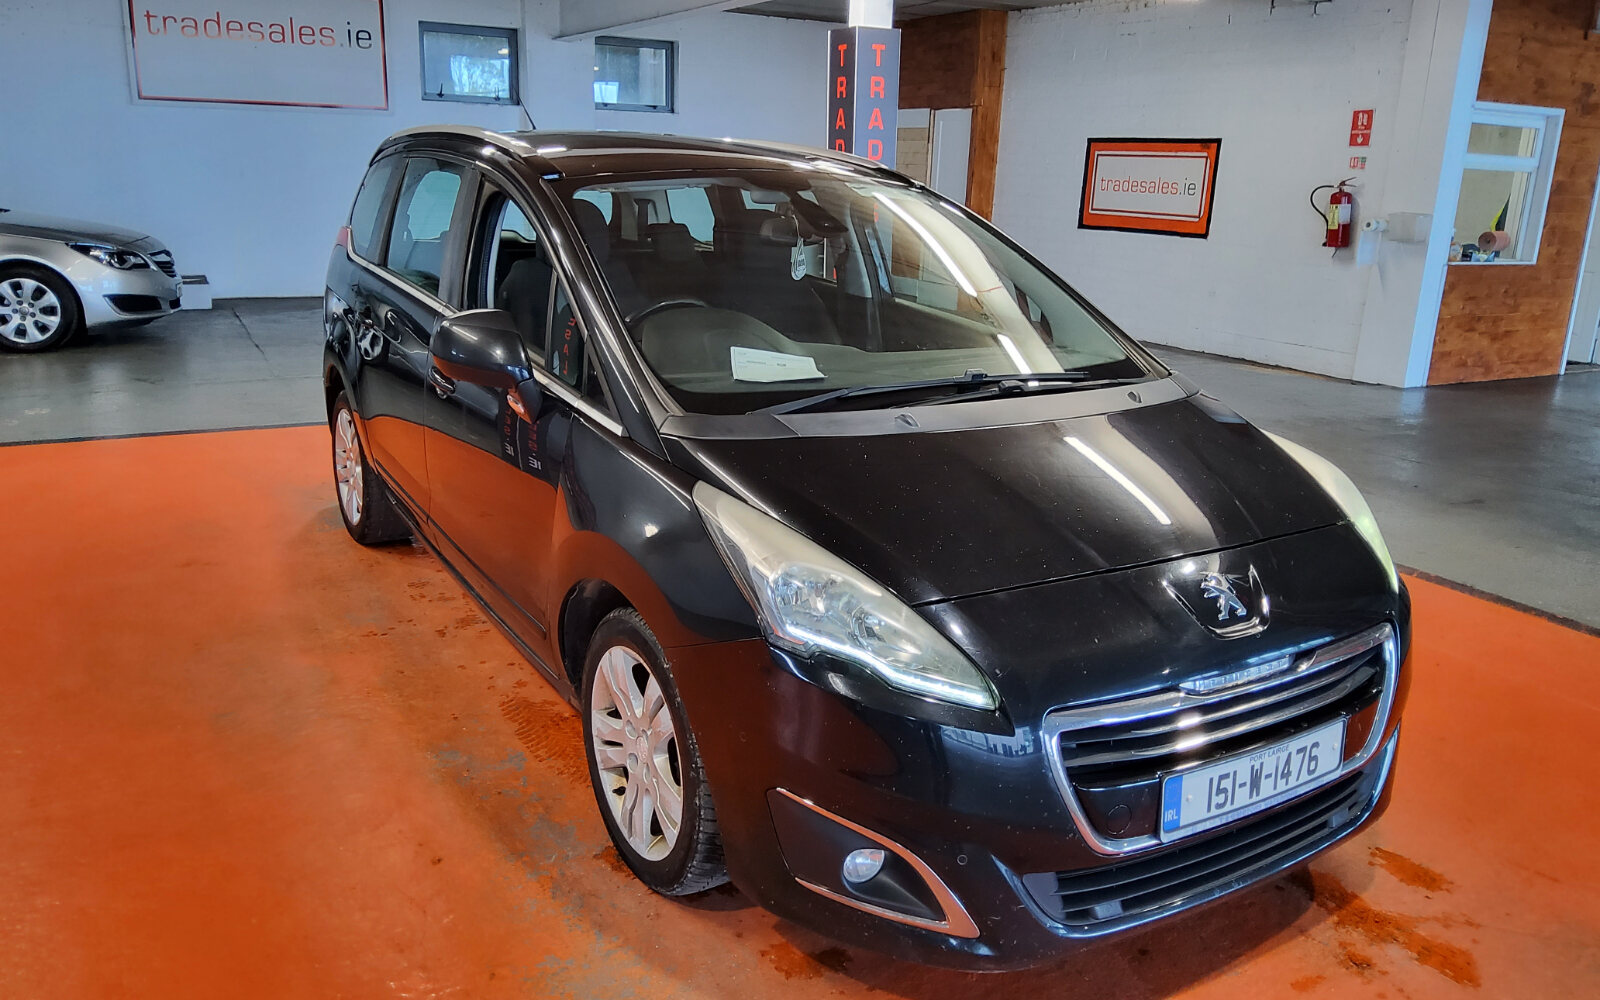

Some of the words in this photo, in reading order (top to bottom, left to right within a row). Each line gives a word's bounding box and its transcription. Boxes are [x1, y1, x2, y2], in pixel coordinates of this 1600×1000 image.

[144, 10, 373, 50] tradesales.ie
[1100, 176, 1197, 197] tradesales.ie
[1249, 752, 1267, 764] PORT
[1206, 741, 1321, 814] 151-W-1476
[1164, 808, 1179, 823] IRL
